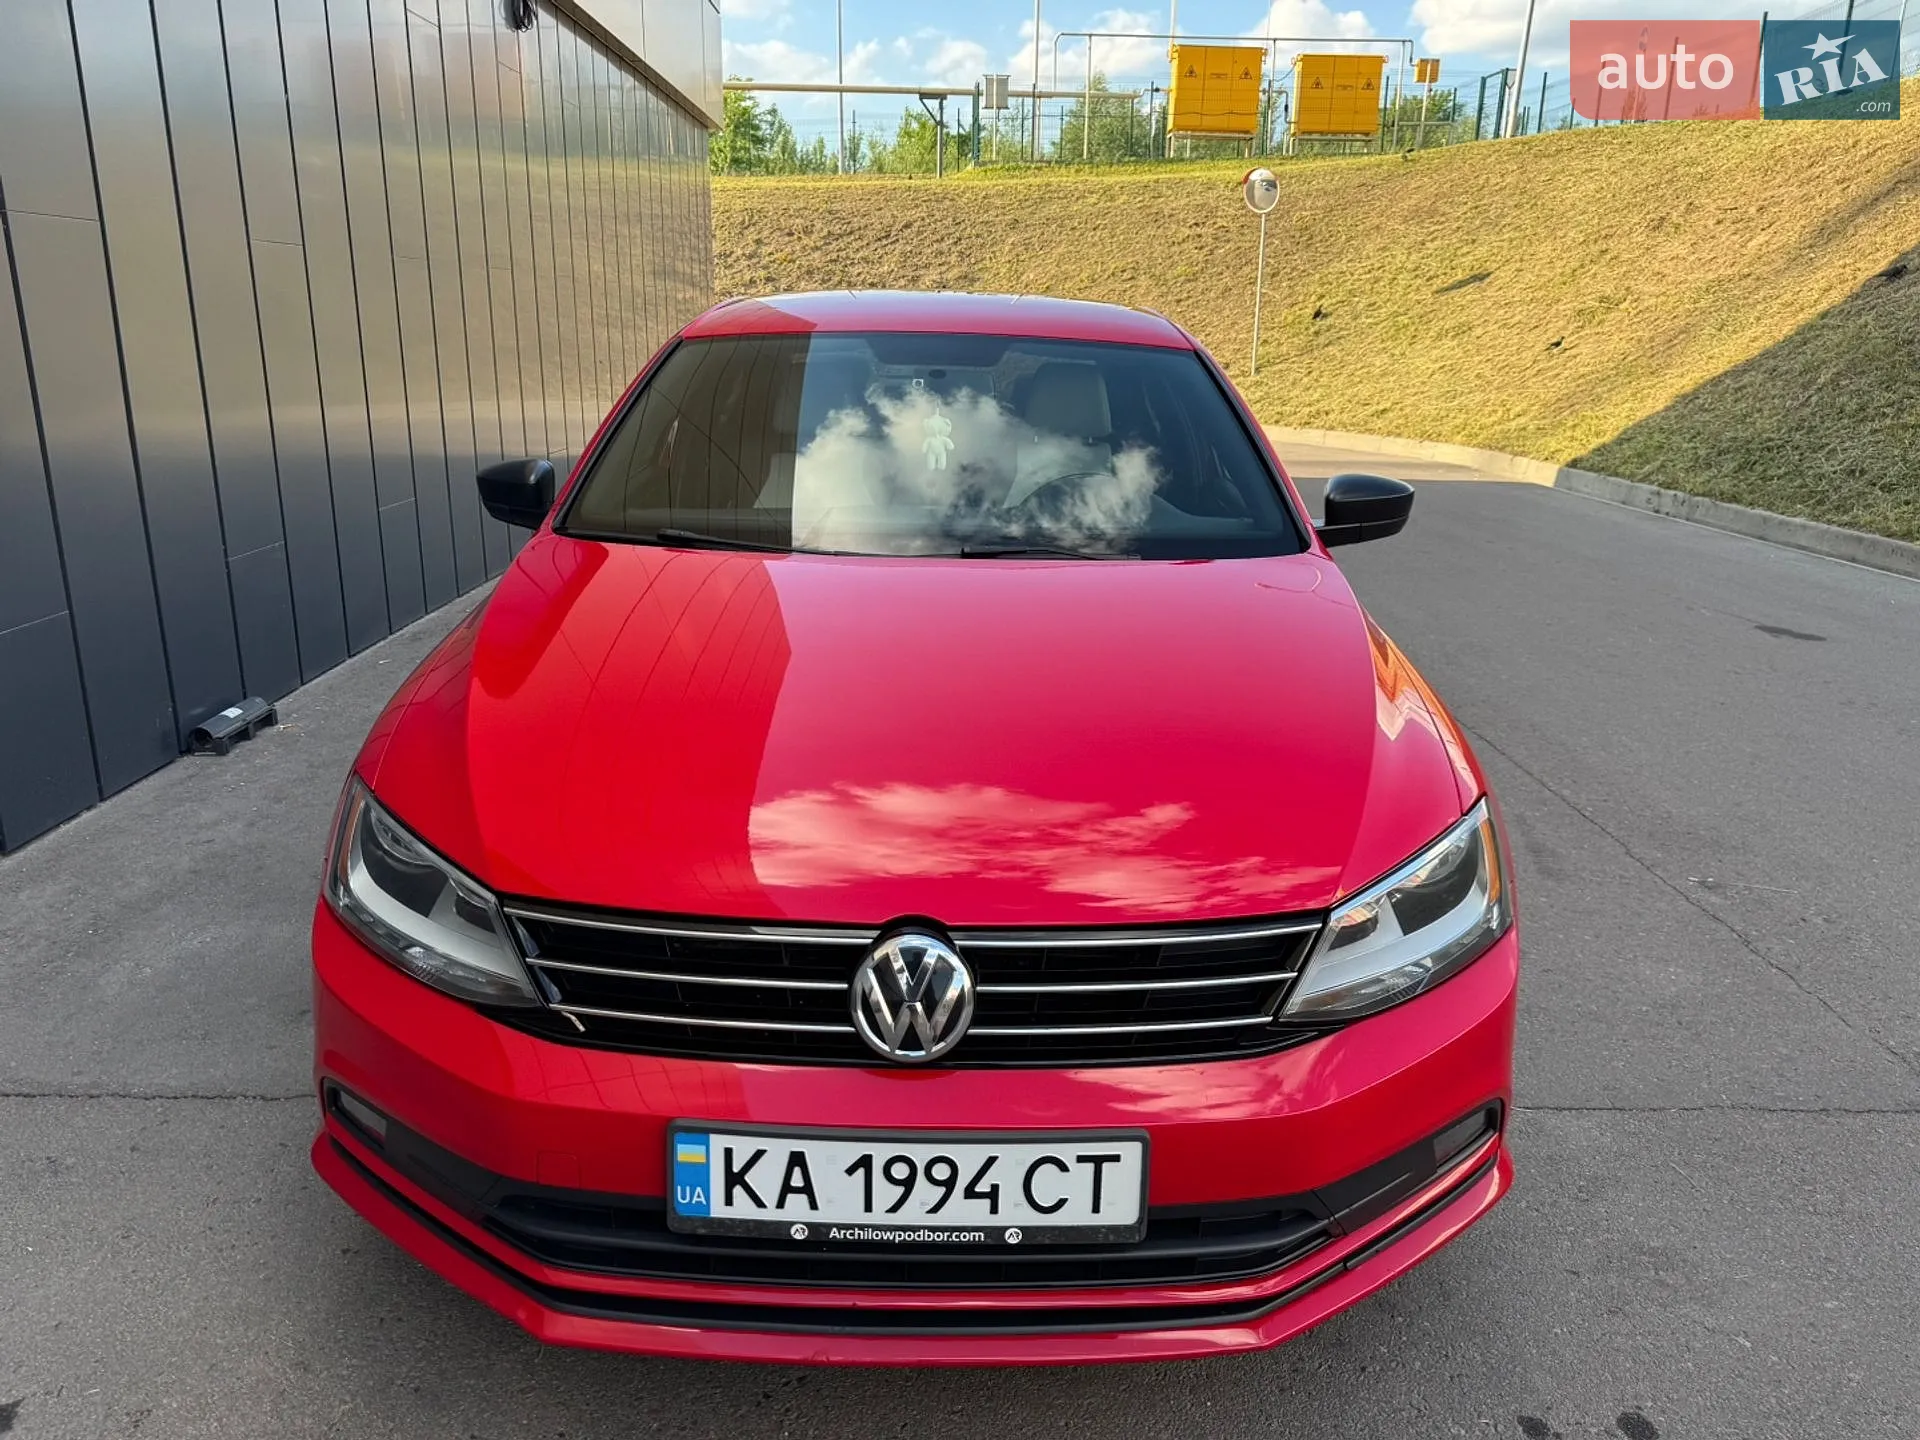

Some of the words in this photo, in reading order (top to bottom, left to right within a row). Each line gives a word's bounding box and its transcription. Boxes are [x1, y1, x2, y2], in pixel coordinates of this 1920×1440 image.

[723, 1147, 819, 1211] KA
[844, 1153, 1000, 1215] 1994
[1023, 1153, 1122, 1215] CT
[677, 1185, 707, 1205] UA
[829, 1226, 985, 1243] Archilowpodbor.com
